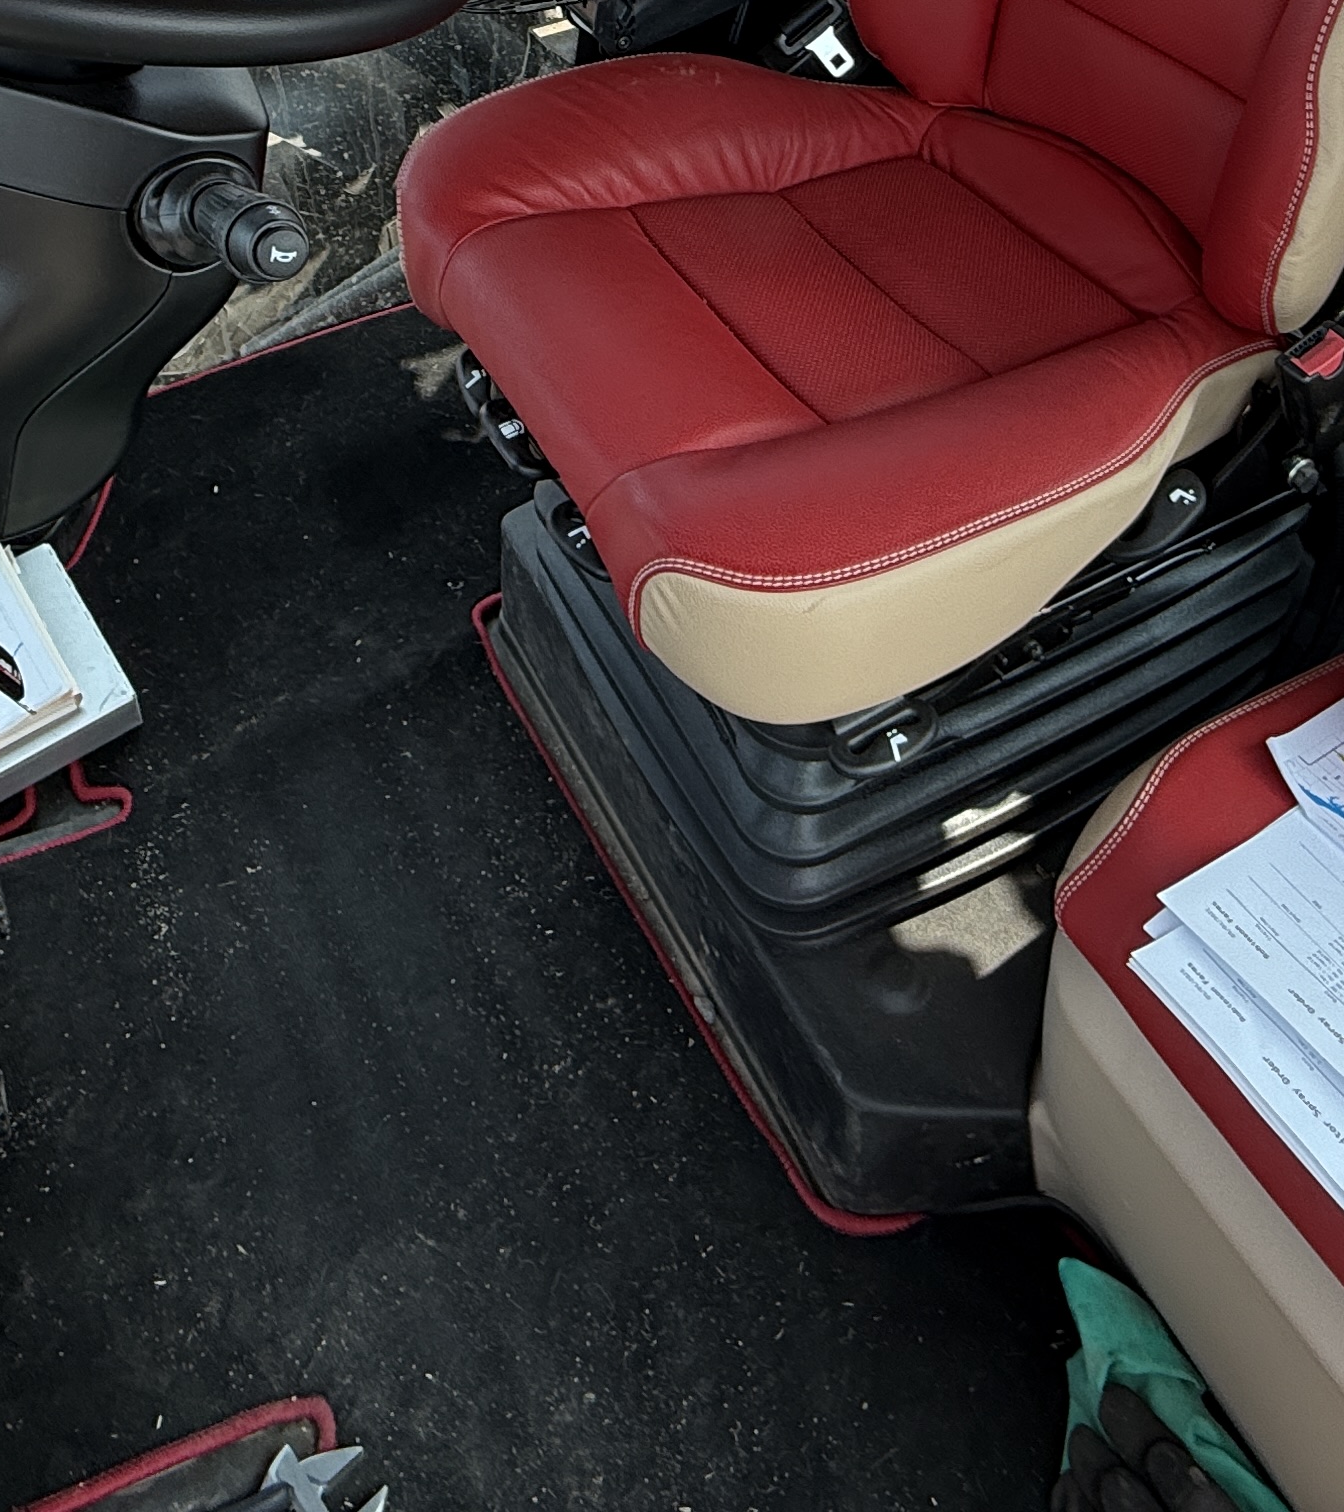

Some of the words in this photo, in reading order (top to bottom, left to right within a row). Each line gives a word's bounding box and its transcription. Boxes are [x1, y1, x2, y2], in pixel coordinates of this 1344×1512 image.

[1287, 989, 1315, 1013] Order
[1318, 1017, 1344, 1043] Spray
[1262, 1056, 1290, 1084] Order
[1292, 1088, 1321, 1117] Spray
